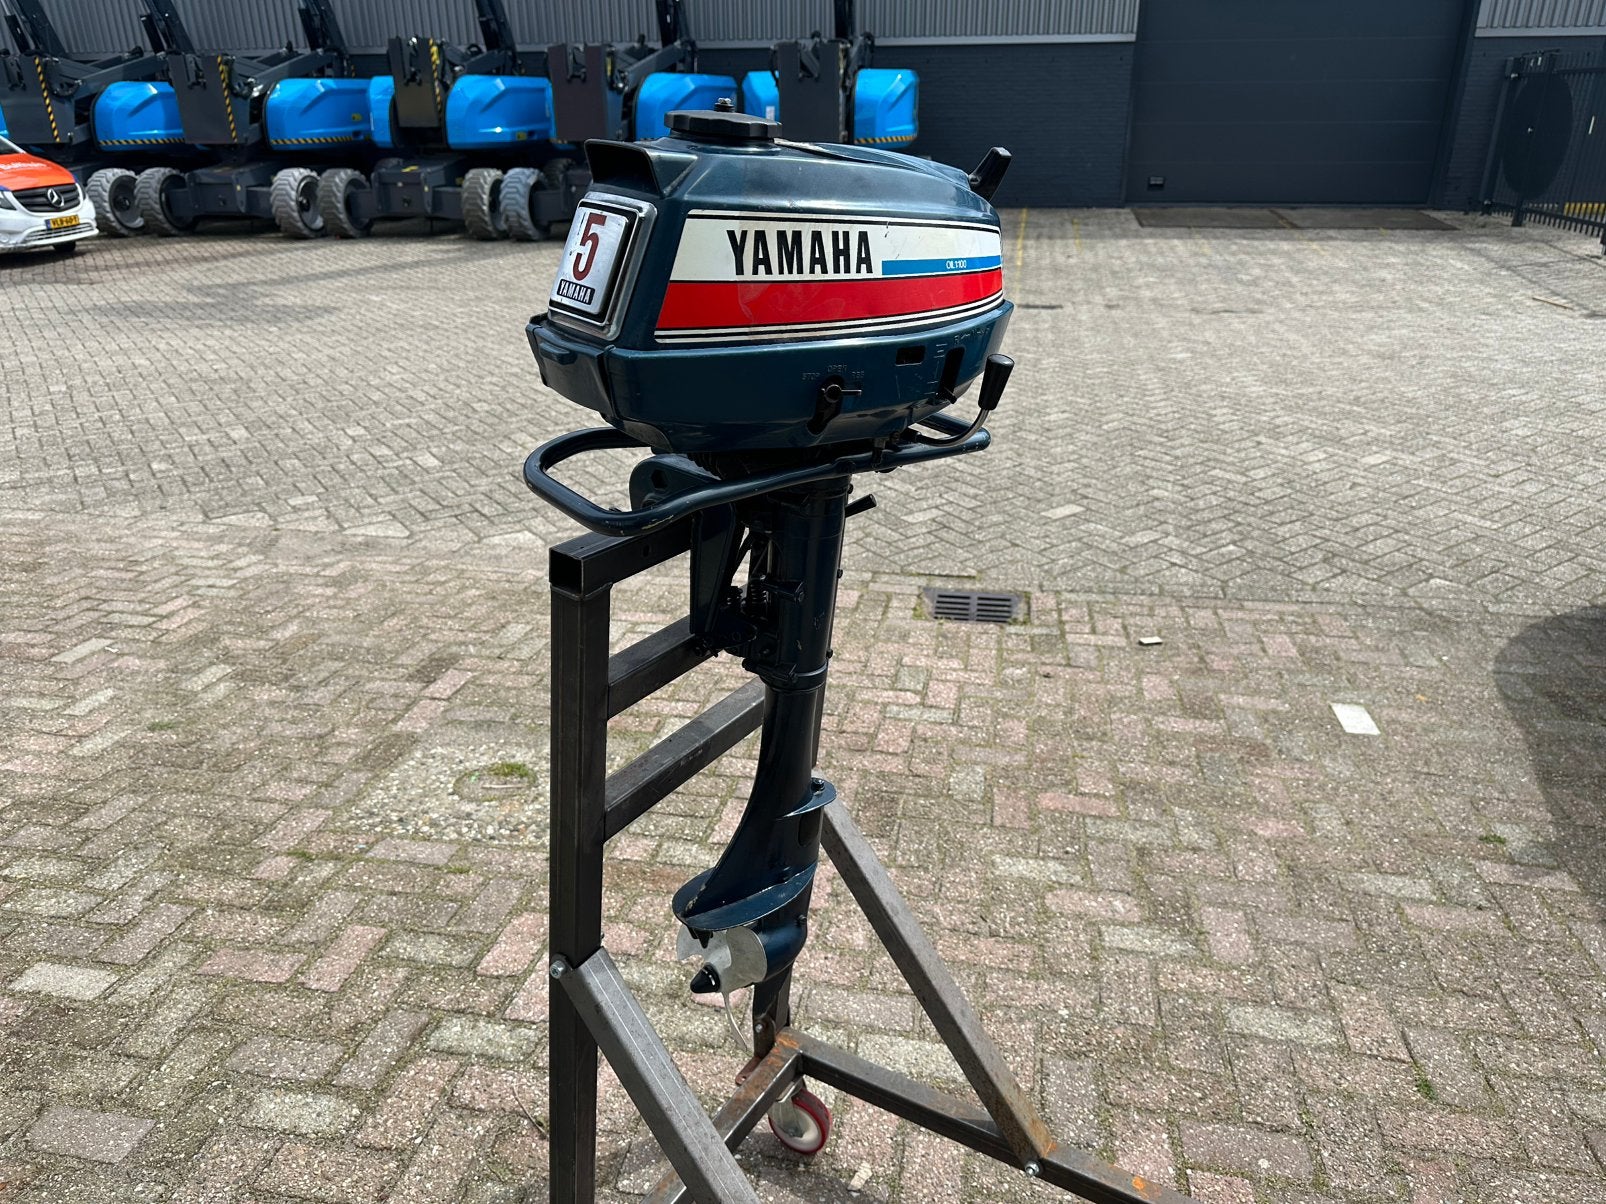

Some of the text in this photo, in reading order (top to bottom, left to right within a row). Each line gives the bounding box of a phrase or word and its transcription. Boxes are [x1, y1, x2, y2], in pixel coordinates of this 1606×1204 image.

[572, 212, 608, 282] 5
[726, 229, 874, 276] YAMAHA
[558, 280, 592, 304] YAMAHA
